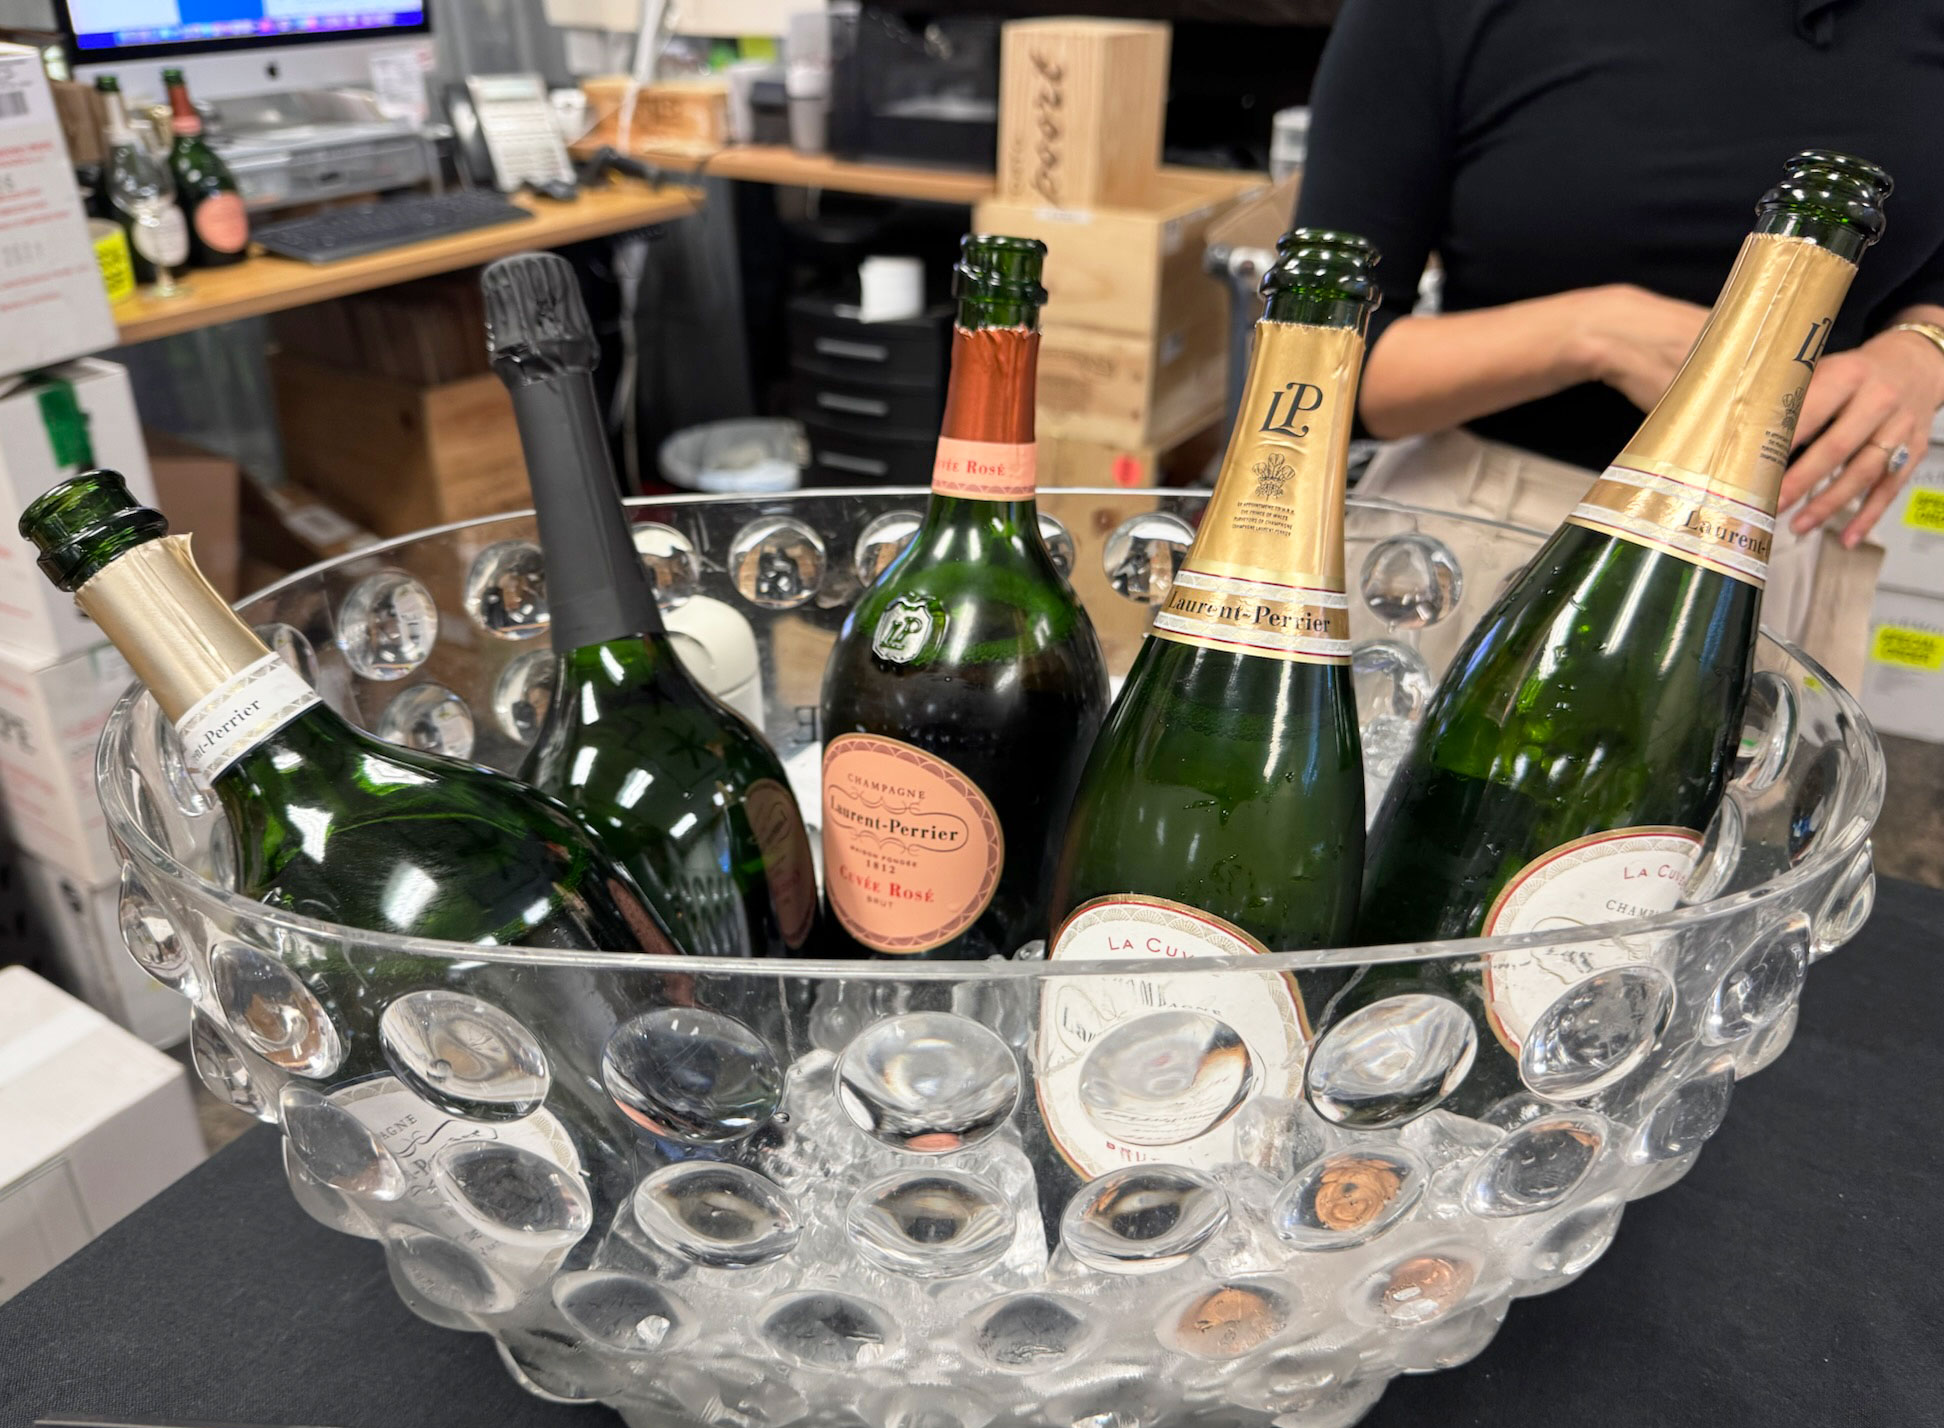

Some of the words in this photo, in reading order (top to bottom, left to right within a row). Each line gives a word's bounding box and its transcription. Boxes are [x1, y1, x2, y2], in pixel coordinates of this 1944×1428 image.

[1259, 382, 1323, 438] LP
[1168, 590, 1331, 633] Laurent-Perrier
[847, 772, 926, 801] CHAMPAGNE
[830, 795, 960, 842] Laurent-Perrier
[866, 859, 896, 875] 1812
